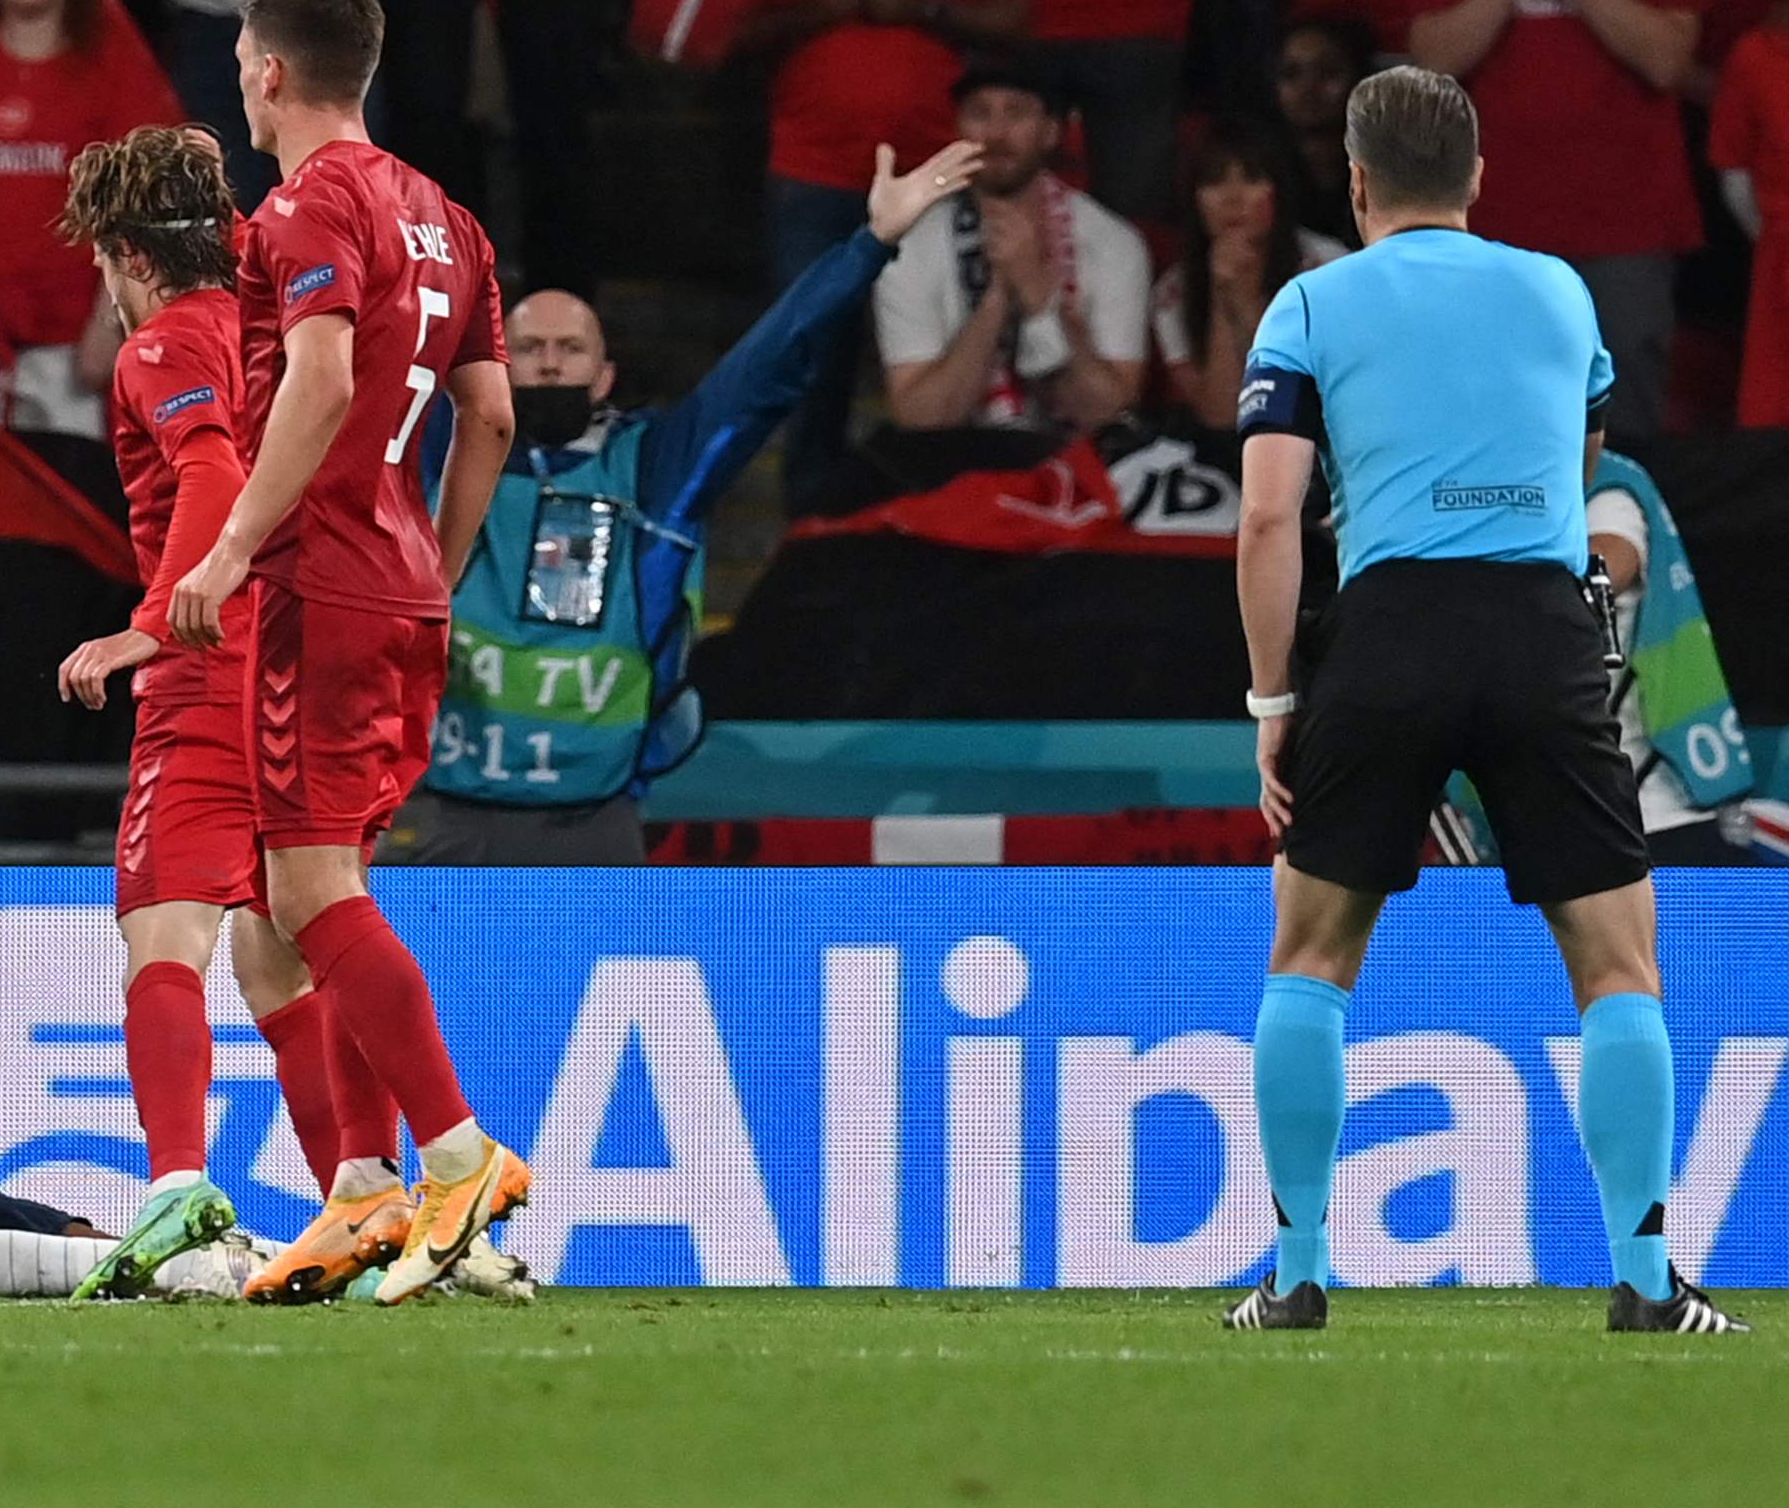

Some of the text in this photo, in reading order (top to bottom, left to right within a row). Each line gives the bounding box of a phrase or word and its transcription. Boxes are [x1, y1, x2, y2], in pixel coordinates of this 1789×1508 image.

[1433, 490, 1545, 508] FOUNDATION
[537, 656, 623, 713] TV
[431, 711, 561, 784] 9-11
